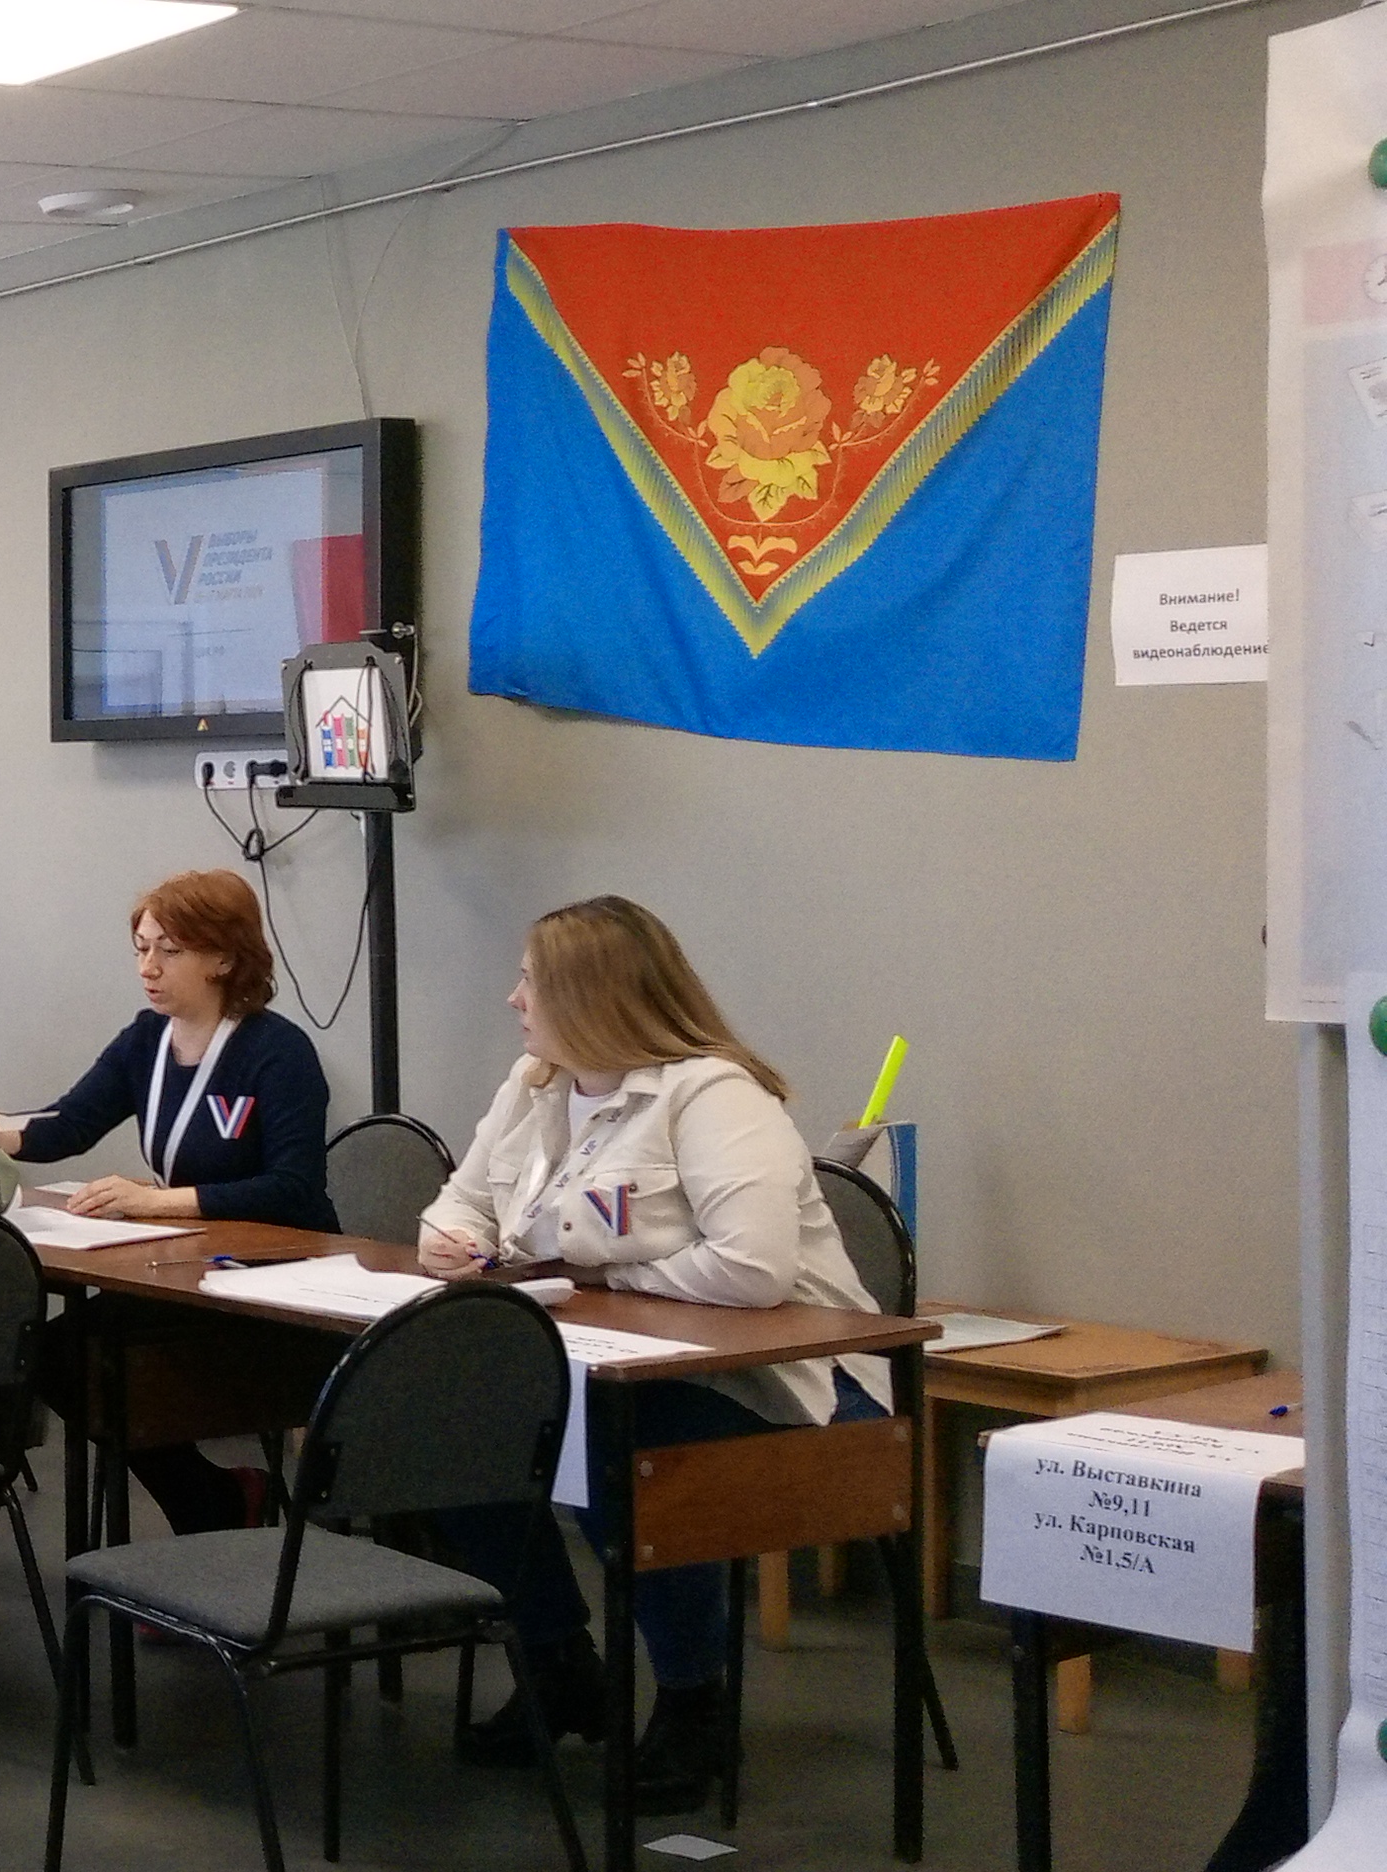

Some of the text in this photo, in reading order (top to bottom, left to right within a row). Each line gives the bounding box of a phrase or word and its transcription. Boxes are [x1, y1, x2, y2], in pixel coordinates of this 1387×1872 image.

[1159, 588, 1240, 606] Внимание!
[1170, 619, 1228, 634] Ведется
[1132, 643, 1269, 660] видеонаблюдение
[1034, 1457, 1202, 1498] ул. Выставкина
[1088, 1490, 1152, 1518] №9,11
[1033, 1512, 1196, 1554] ул. Карповская
